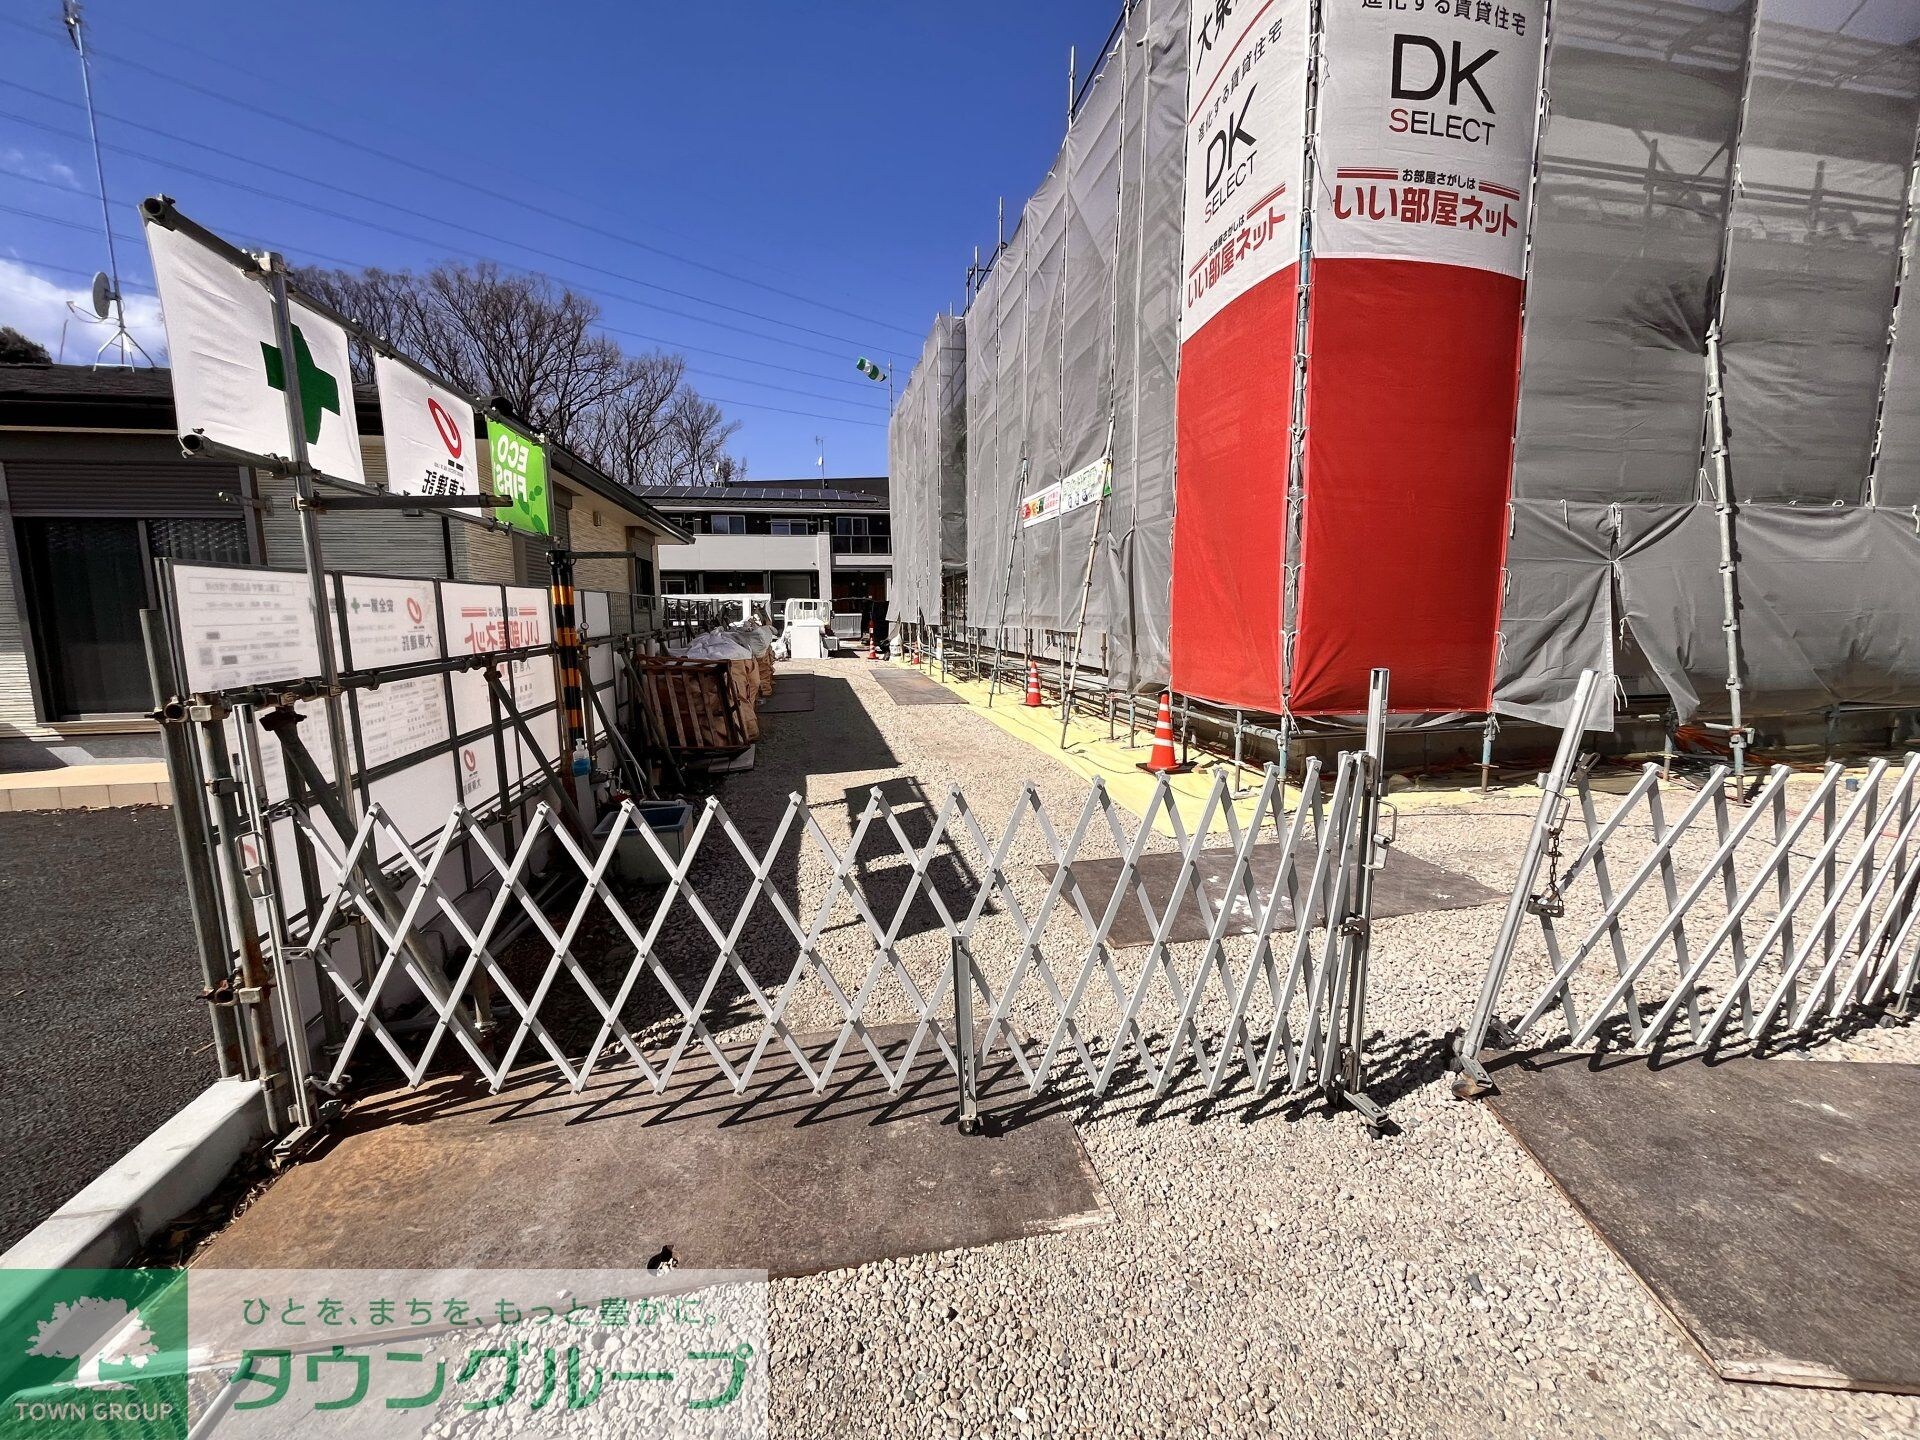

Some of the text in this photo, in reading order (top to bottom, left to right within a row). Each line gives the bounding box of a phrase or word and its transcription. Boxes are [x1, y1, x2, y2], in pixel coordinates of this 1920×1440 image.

[1198, 17, 1283, 142] 進化する賃貸住宅
[1391, 33, 1499, 115] DK
[1205, 82, 1258, 199] DK
[1389, 109, 1496, 146] SELECT
[1204, 150, 1258, 224] SELECT
[1333, 184, 1518, 237] いい部屋ネット
[1402, 168, 1476, 190] お部屋さがしは
[1188, 206, 1286, 308] いい部屋ネット
